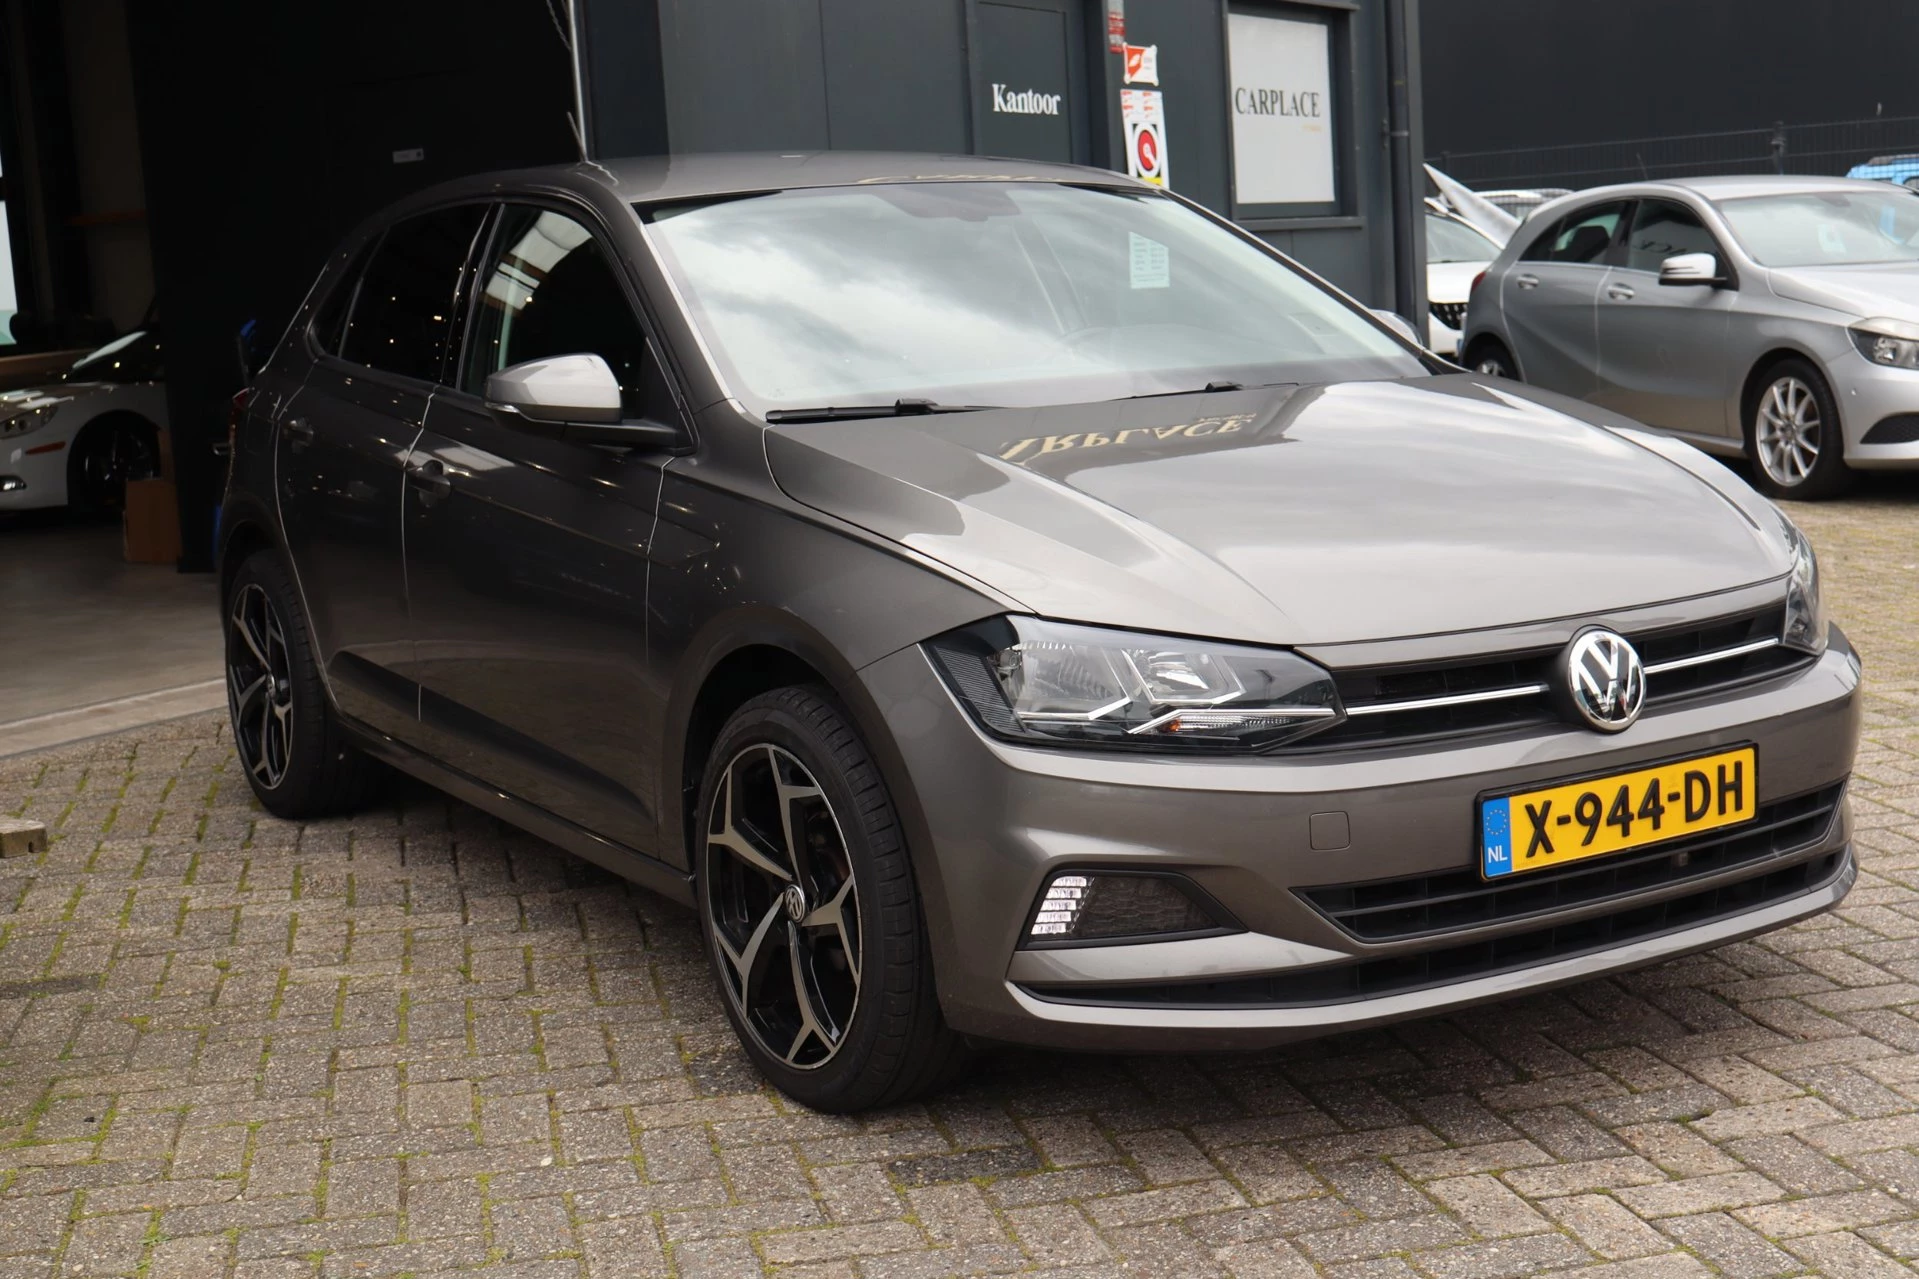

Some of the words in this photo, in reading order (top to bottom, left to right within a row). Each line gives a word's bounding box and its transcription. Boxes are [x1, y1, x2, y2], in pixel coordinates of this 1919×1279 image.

[992, 83, 1061, 115] Kantoor
[1235, 87, 1321, 118] CARPLACE
[1525, 760, 1743, 858] X-944-DH
[1487, 845, 1508, 864] NL
